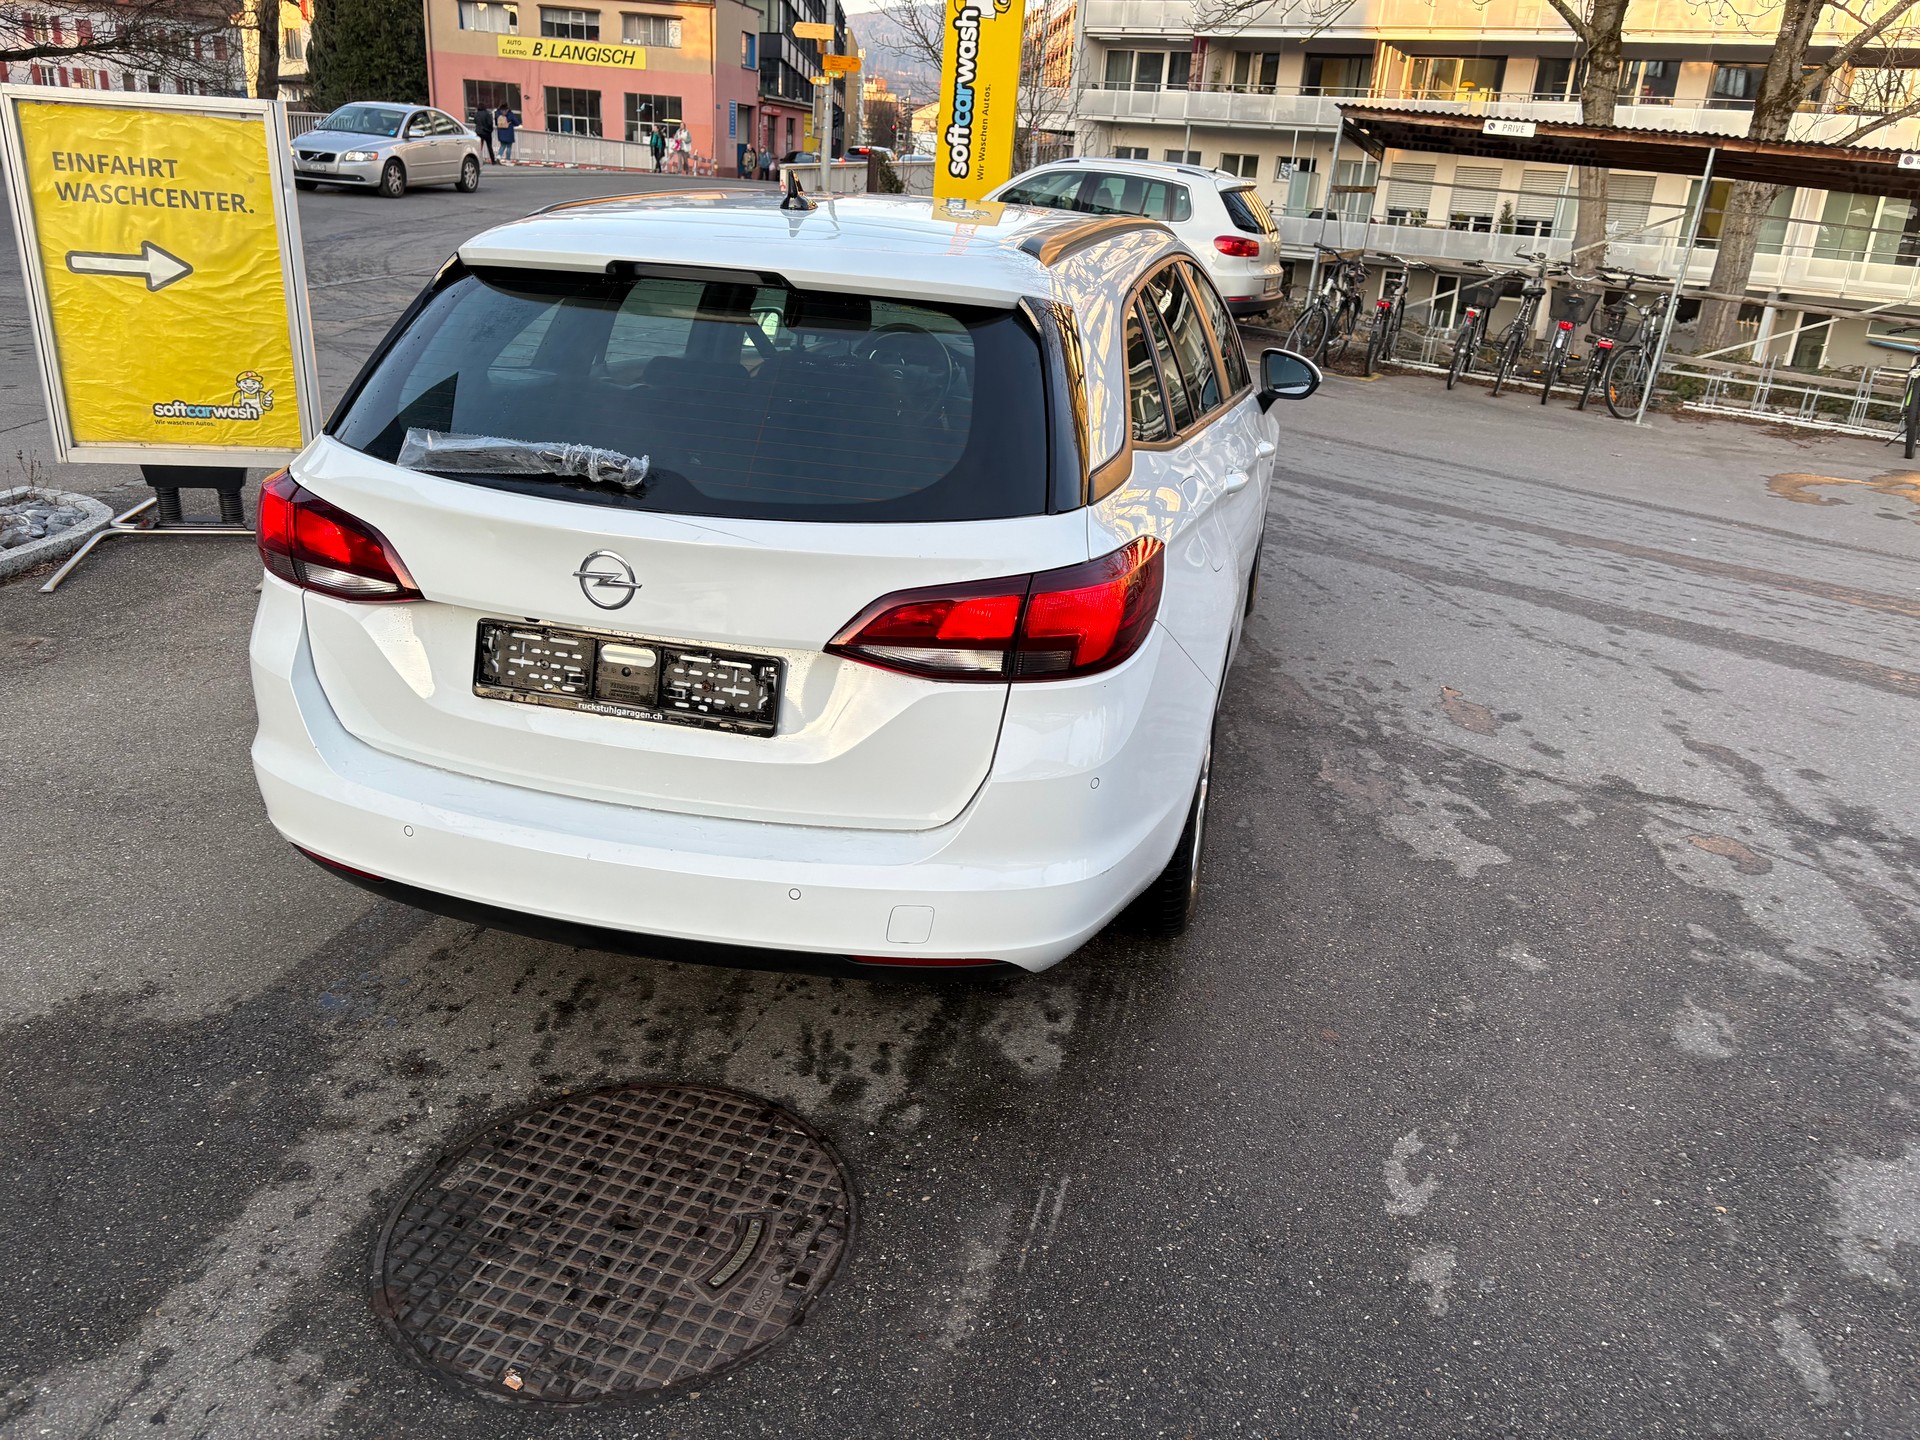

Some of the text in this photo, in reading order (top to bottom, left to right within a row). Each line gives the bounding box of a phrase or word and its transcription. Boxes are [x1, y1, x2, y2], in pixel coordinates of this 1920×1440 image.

[502, 48, 527, 56] ELEKTRO
[945, 6, 981, 179] softcarwash
[976, 83, 992, 181] Wir Waschen Autos.
[51, 151, 178, 179] EINFAHRT
[54, 181, 256, 215] WASCHCENTER.
[153, 400, 259, 420] softcarwash
[577, 702, 663, 721] ruckstuhlgaragen.ch
[752, 1288, 773, 1311] D400
